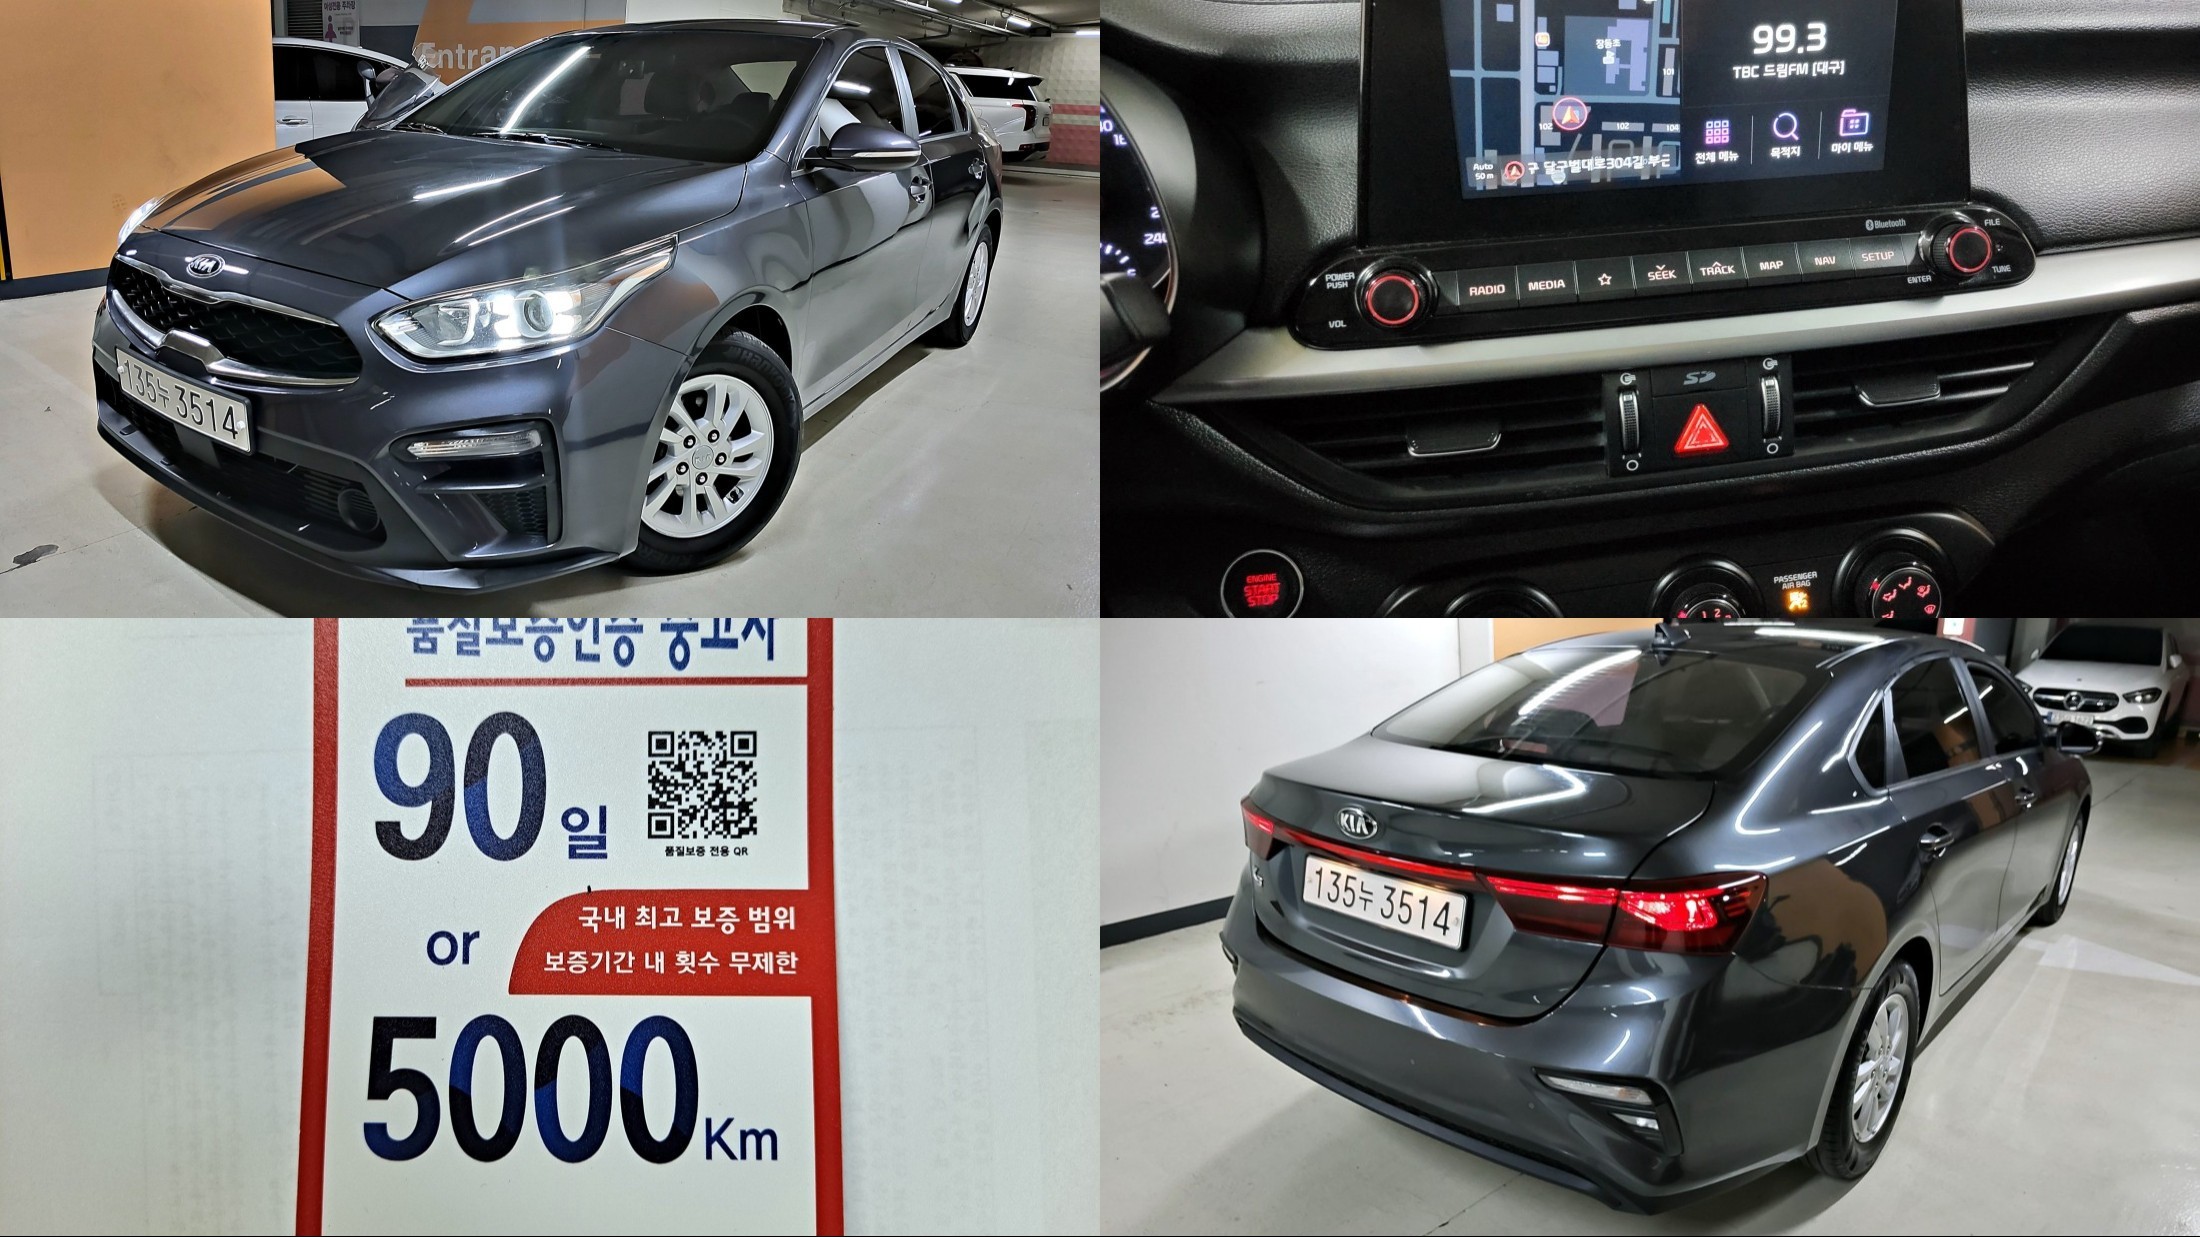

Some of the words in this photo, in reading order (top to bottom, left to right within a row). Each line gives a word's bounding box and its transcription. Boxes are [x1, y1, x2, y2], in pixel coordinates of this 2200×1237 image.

[1753, 22, 1827, 54] 99.3
[1662, 68, 1675, 76] 101
[1732, 65, 1760, 79] TBC
[1763, 62, 1809, 78] 드림FM
[1812, 60, 1846, 77] [대구]
[1539, 122, 1553, 131] 102
[1616, 122, 1630, 130] 102
[1666, 123, 1680, 131] 104
[1770, 146, 1801, 160] 목적지
[1831, 142, 1851, 155] 마이
[1853, 141, 1874, 153] 메뉴
[1695, 152, 1716, 165] 전체
[1718, 151, 1740, 163] 메뉴
[1473, 162, 1494, 171] Auto
[1474, 172, 1485, 181] 50
[1874, 218, 1907, 229] Bluetooth
[1984, 217, 2001, 227] FILE
[1814, 255, 1837, 266] NAV
[1861, 251, 1895, 262] SETUP
[1699, 265, 1736, 277] TRACK
[1759, 260, 1784, 271] MAP
[1992, 264, 2011, 274] TUNE
[1325, 272, 1356, 283] POWER
[1647, 269, 1677, 281] SEEK
[1907, 275, 1932, 284] ENTER
[1326, 281, 1349, 290] PUSH
[1469, 284, 1506, 297] RADIO
[1527, 279, 1566, 292] MEDIA
[1328, 319, 1347, 329] VOL
[1682, 370, 1717, 386] SD
[124, 360, 170, 409] 135누
[174, 385, 238, 440] 3514
[1246, 573, 1278, 584] ENGINE
[1773, 571, 1818, 584] PASSENGER
[1243, 582, 1281, 597] START
[1781, 581, 1795, 590] AIR
[1795, 579, 1811, 589] BAG
[1247, 593, 1279, 608] STOP
[1714, 608, 1721, 618] 2
[374, 711, 547, 861] 90
[561, 805, 608, 859] 일
[665, 845, 706, 857] 품질보증
[709, 846, 730, 857] 전용
[733, 847, 749, 856] QR
[1315, 866, 1374, 912] 135누
[1380, 884, 1451, 936] 3514
[578, 906, 626, 934] 국내
[635, 906, 683, 930] 최고
[690, 906, 741, 935] 보증
[748, 906, 796, 934] 범위
[426, 930, 480, 966] or
[543, 951, 636, 975] 보증기간
[644, 951, 665, 974] 내
[674, 951, 721, 975] 횟수
[729, 951, 799, 975] 무제한
[363, 1014, 699, 1164] 5000
[705, 1117, 779, 1162] Km
